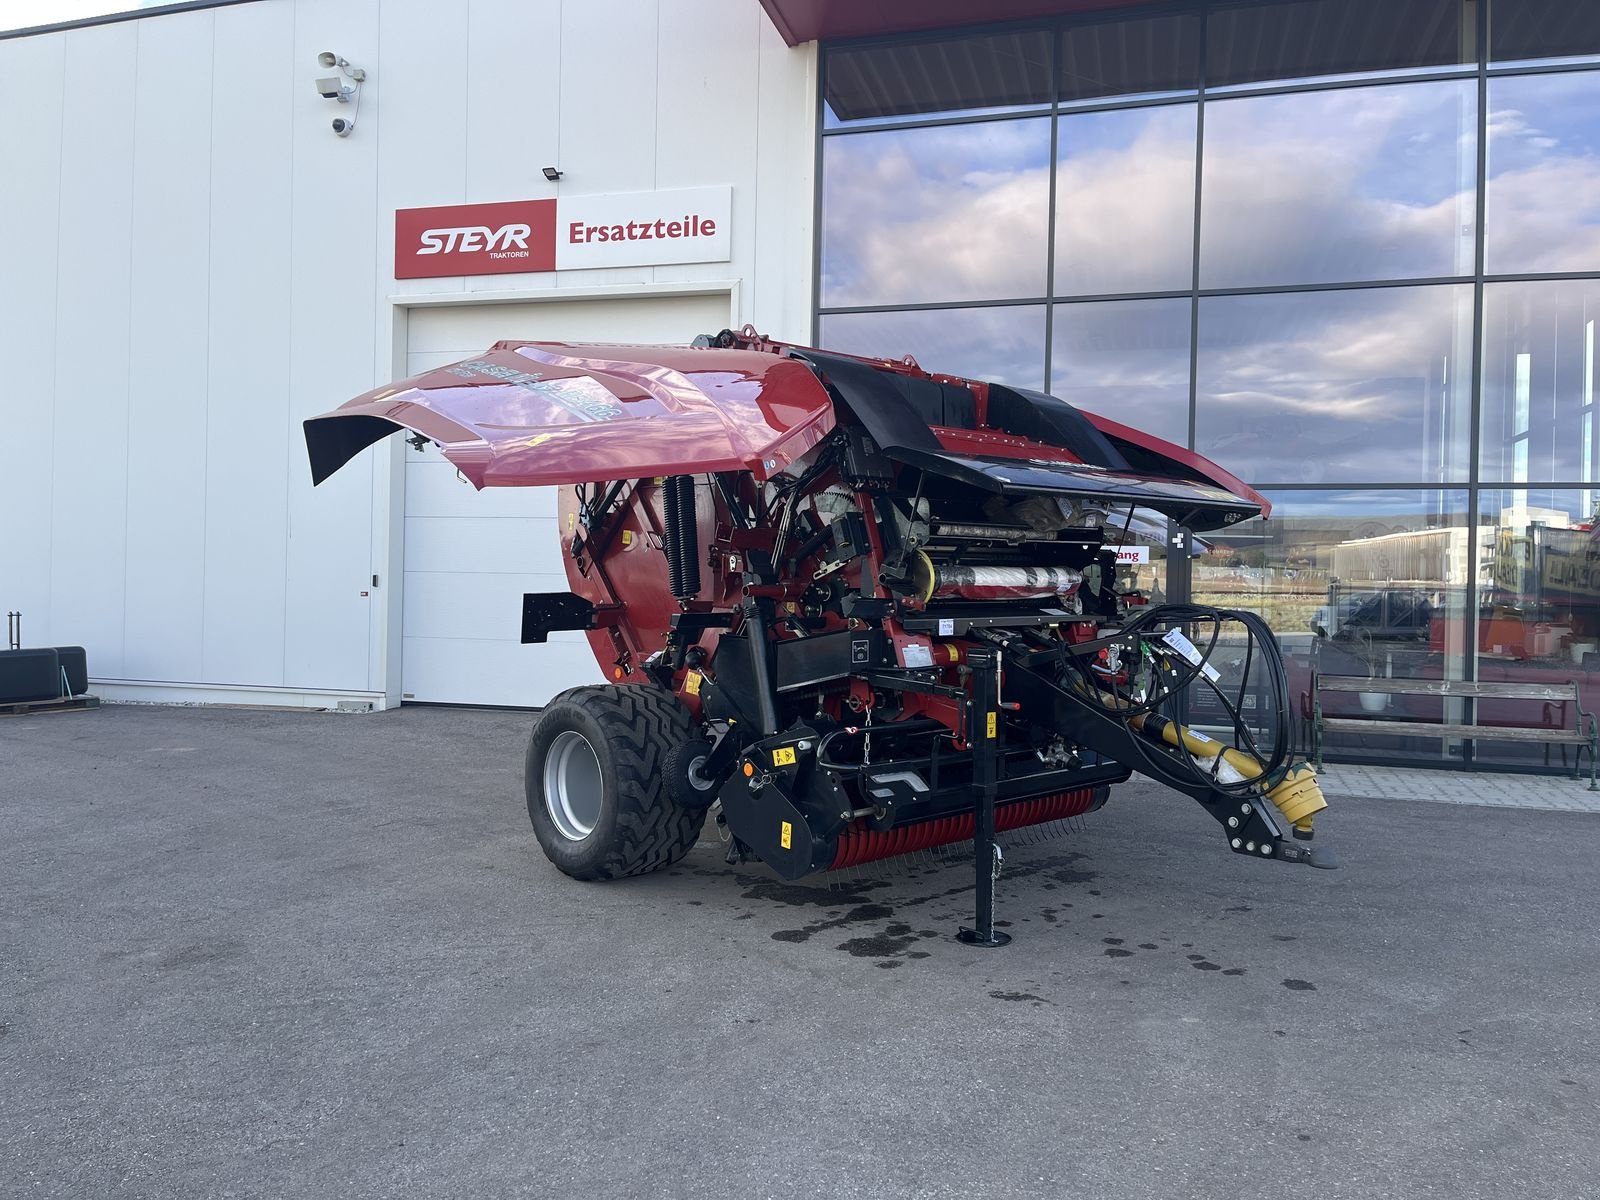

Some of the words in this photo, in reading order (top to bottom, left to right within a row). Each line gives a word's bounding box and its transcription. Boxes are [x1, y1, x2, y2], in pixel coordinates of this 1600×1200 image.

[416, 223, 531, 255] STEYR
[569, 215, 716, 244] Ersatzteile
[489, 251, 529, 259] TRAKTOREN
